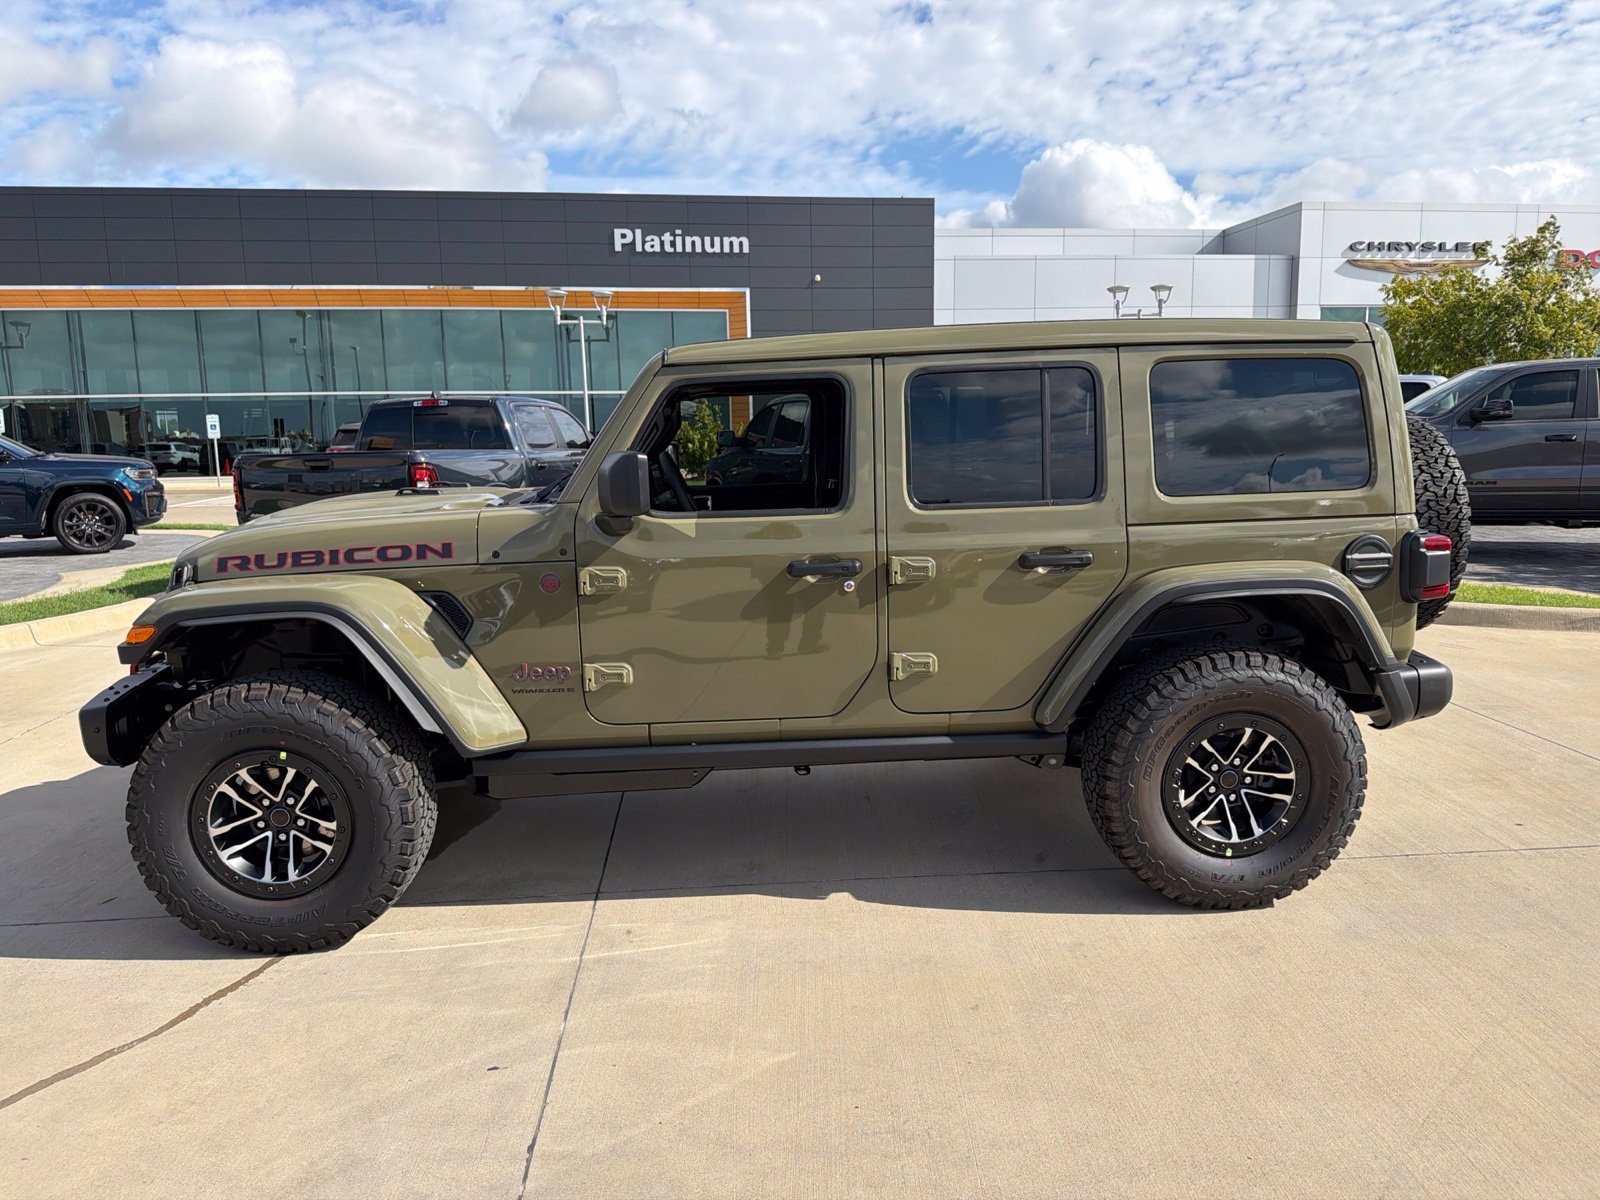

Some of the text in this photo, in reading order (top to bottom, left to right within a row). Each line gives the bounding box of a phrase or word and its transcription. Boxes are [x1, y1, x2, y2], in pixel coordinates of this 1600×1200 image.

[613, 228, 750, 253] Platinum
[1350, 240, 1485, 253] CHRYSLE
[216, 542, 454, 574] RUBICON
[512, 661, 572, 684] Jeep
